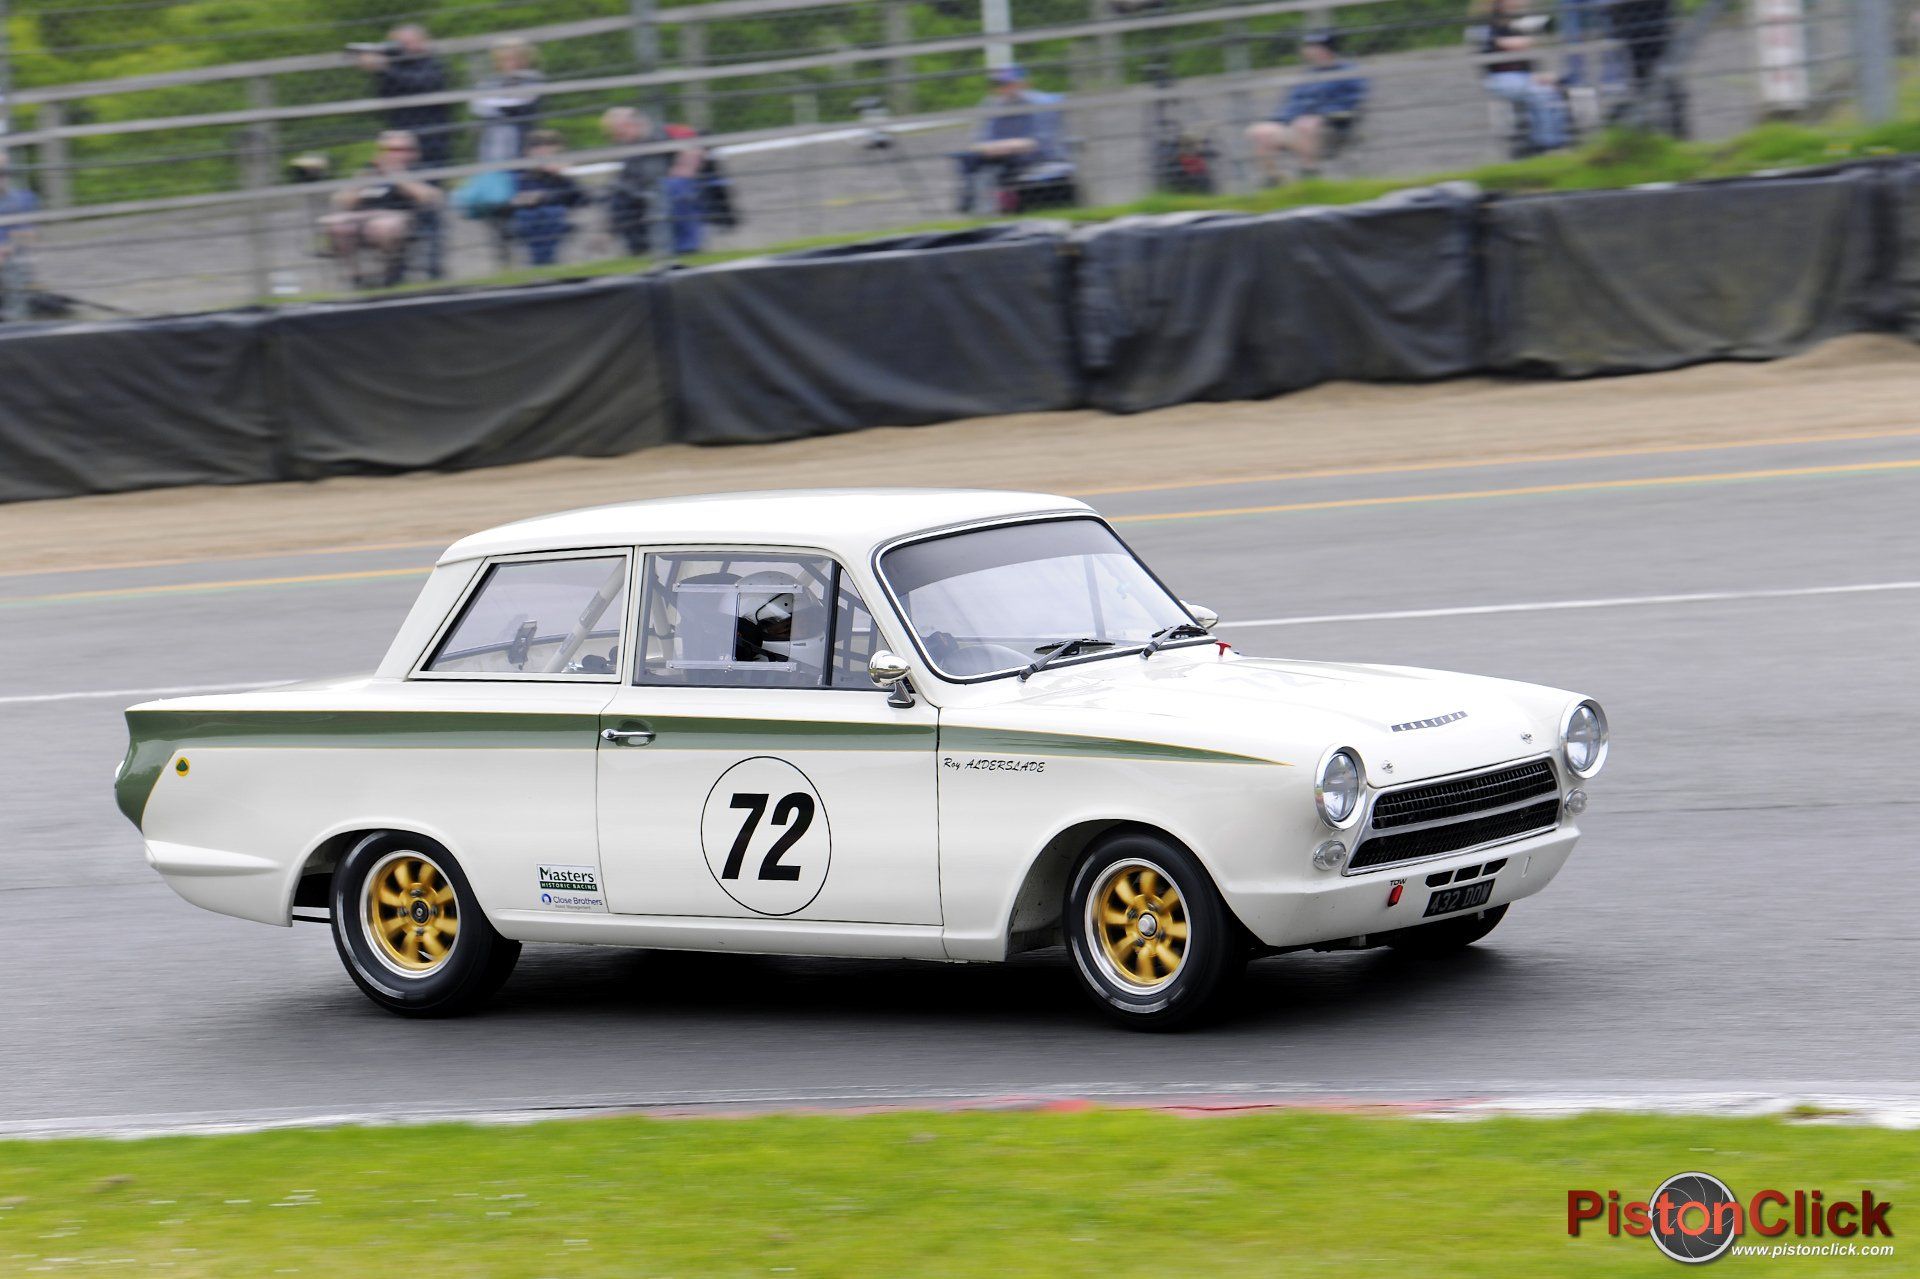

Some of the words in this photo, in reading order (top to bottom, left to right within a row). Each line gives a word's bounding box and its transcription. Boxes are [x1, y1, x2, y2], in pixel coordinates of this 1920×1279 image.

[943, 757, 960, 770] Roy
[964, 759, 1046, 773] ALDERSLADE
[721, 791, 815, 882] 72
[539, 866, 595, 882] Masters
[1389, 877, 1408, 886] TOW
[553, 896, 573, 904] Close
[573, 896, 603, 906] Brothers
[1429, 890, 1461, 913] 432
